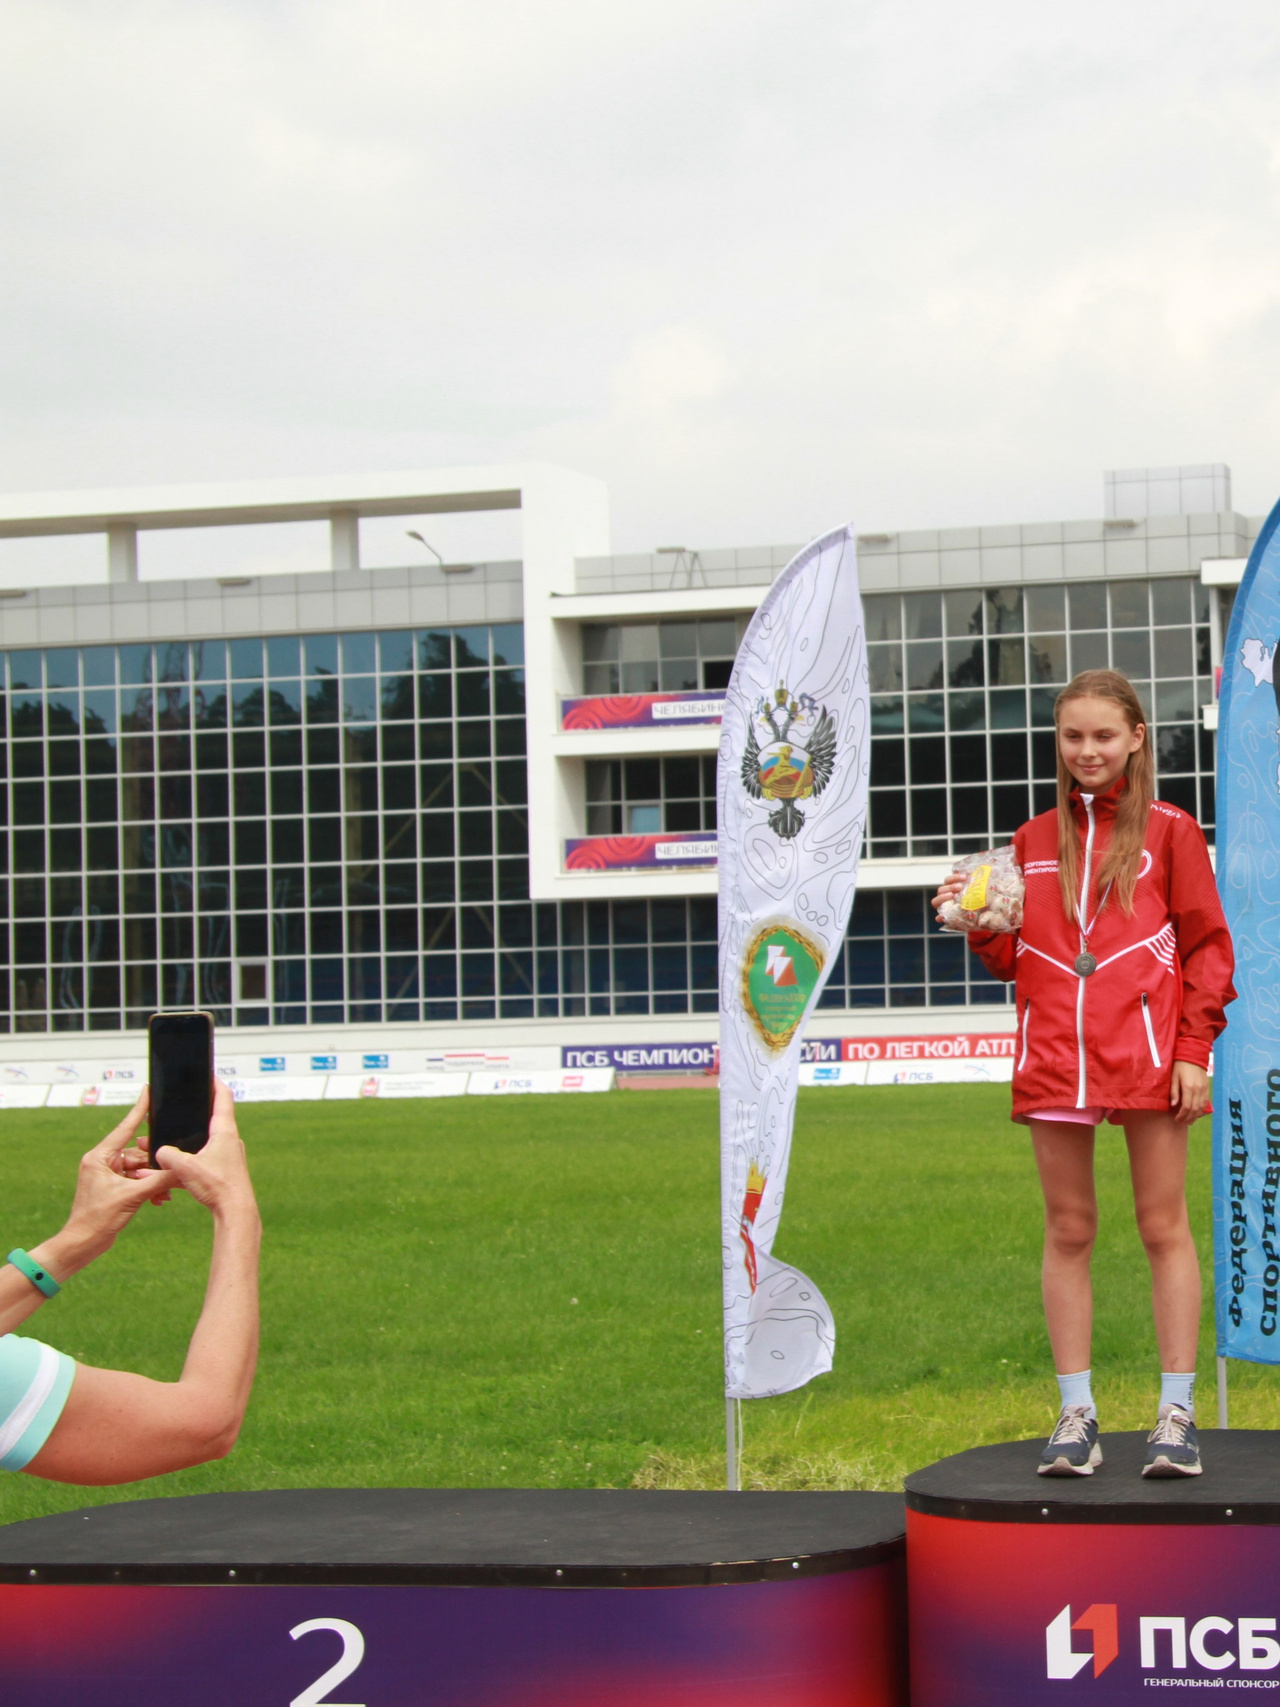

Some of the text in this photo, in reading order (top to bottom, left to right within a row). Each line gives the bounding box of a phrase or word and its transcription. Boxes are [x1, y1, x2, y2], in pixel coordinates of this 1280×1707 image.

[567, 1050, 610, 1068] ПСБ
[848, 1043, 880, 1060] ПО
[885, 1036, 971, 1059] ЛЕГКОЙ
[1228, 1097, 1249, 1328] Федерация
[289, 1617, 366, 1707] 2
[1144, 1677, 1280, 1689] ГЕНЕРАЛЬНЫЙ СПОНСОР
